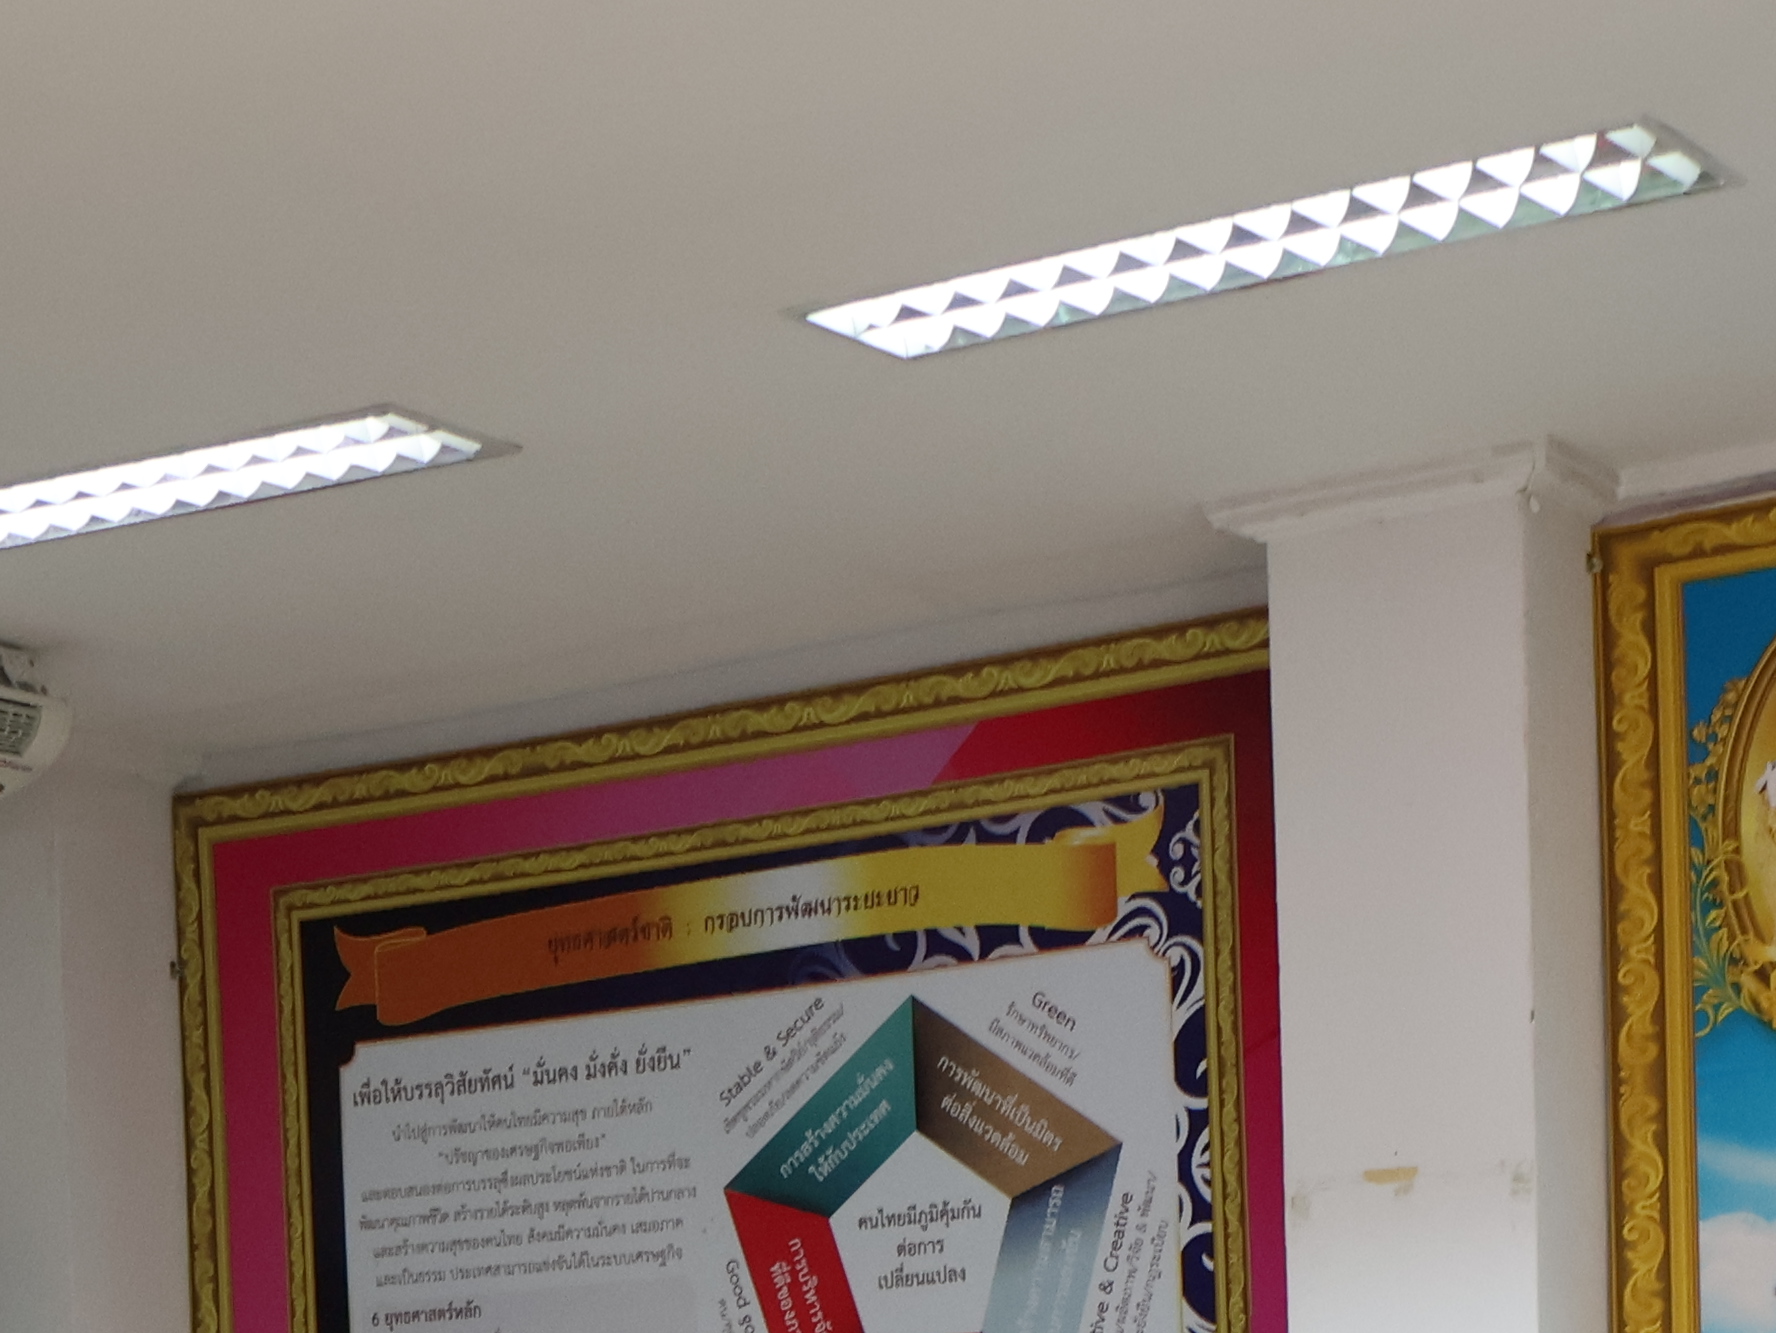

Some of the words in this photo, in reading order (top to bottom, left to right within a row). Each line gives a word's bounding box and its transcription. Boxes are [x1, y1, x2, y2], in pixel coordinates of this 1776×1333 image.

[1031, 990, 1078, 1032] Green
[719, 1059, 764, 1108] Stable
[763, 1044, 777, 1061] &
[776, 997, 826, 1047] Secure
[352, 1062, 516, 1107] เพื่อให้บรรลุวิสัยทัศน์
[936, 1055, 1065, 1153] การพัฒนาที่เป็นมิตร
[940, 1092, 1030, 1167] ต่อสิ่งแวดล้อม
[858, 1197, 982, 1233] คนไทยมีภูมิคุ้มกัน
[1103, 1191, 1134, 1273] Creative
[896, 1236, 945, 1258] ต่อการ
[725, 1257, 751, 1310] Good
[877, 1262, 967, 1291] เปลี่ยนแปลง
[1098, 1279, 1114, 1295] &
[371, 1312, 380, 1327] 6
[385, 1299, 483, 1331] ยุทธศาสตร์หลัก
